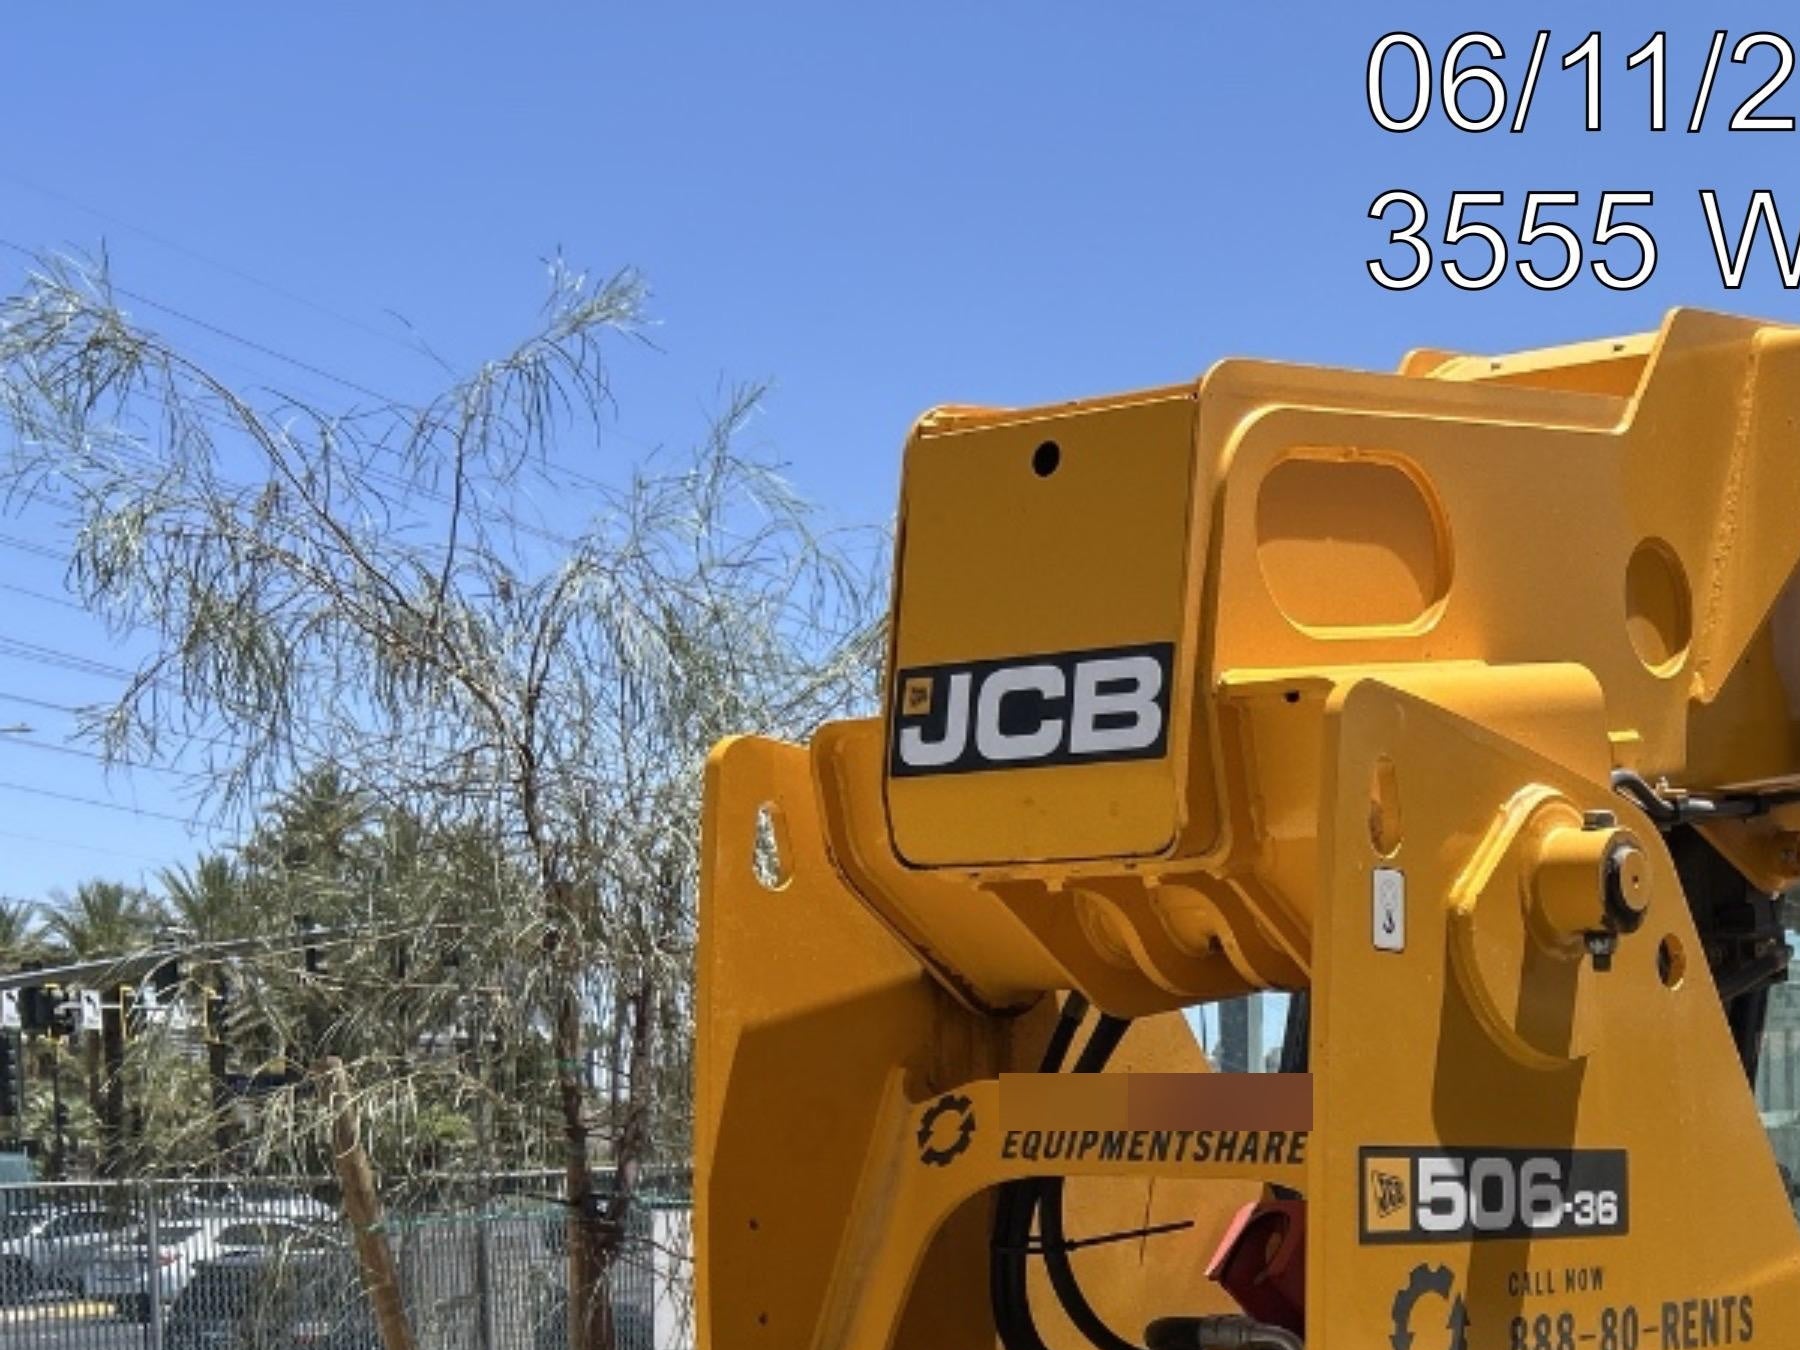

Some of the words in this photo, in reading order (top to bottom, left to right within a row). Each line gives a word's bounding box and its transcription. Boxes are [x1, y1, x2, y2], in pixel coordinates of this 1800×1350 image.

[900, 655, 1163, 767] JCB
[1001, 1130, 1309, 1165] EQUIPMENTSHARE
[1507, 1269, 1556, 1298] CALL
[1565, 1265, 1605, 1293] NOW
